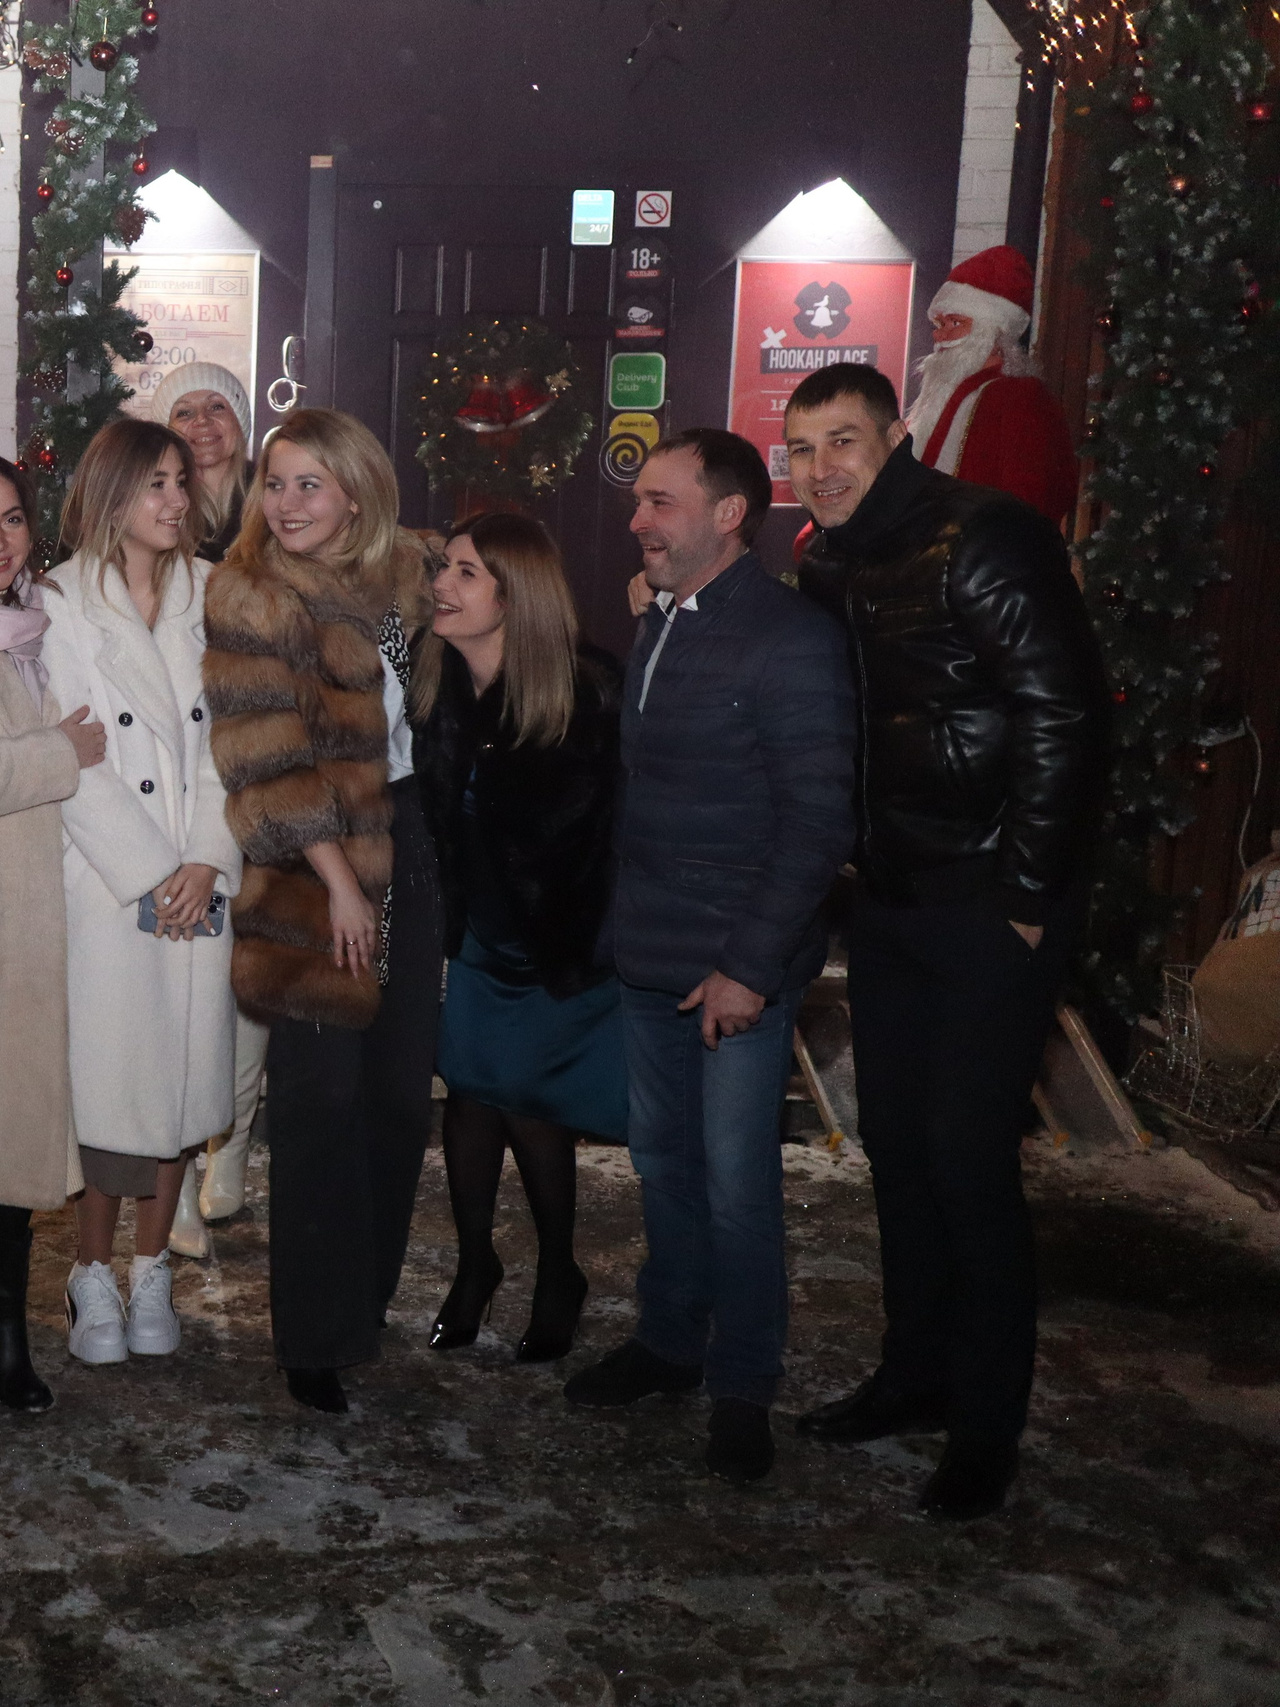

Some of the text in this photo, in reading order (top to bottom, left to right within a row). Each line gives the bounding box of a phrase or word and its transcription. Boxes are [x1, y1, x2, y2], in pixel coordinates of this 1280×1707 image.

[589, 224, 609, 233] 24/7
[631, 248, 661, 270] 18+
[137, 279, 201, 290] ТИПОГРАФИЯ
[112, 303, 230, 322] БОТАЕМ
[769, 349, 824, 369] HOOKAH
[616, 373, 658, 384] Delivery
[616, 383, 640, 392] Club
